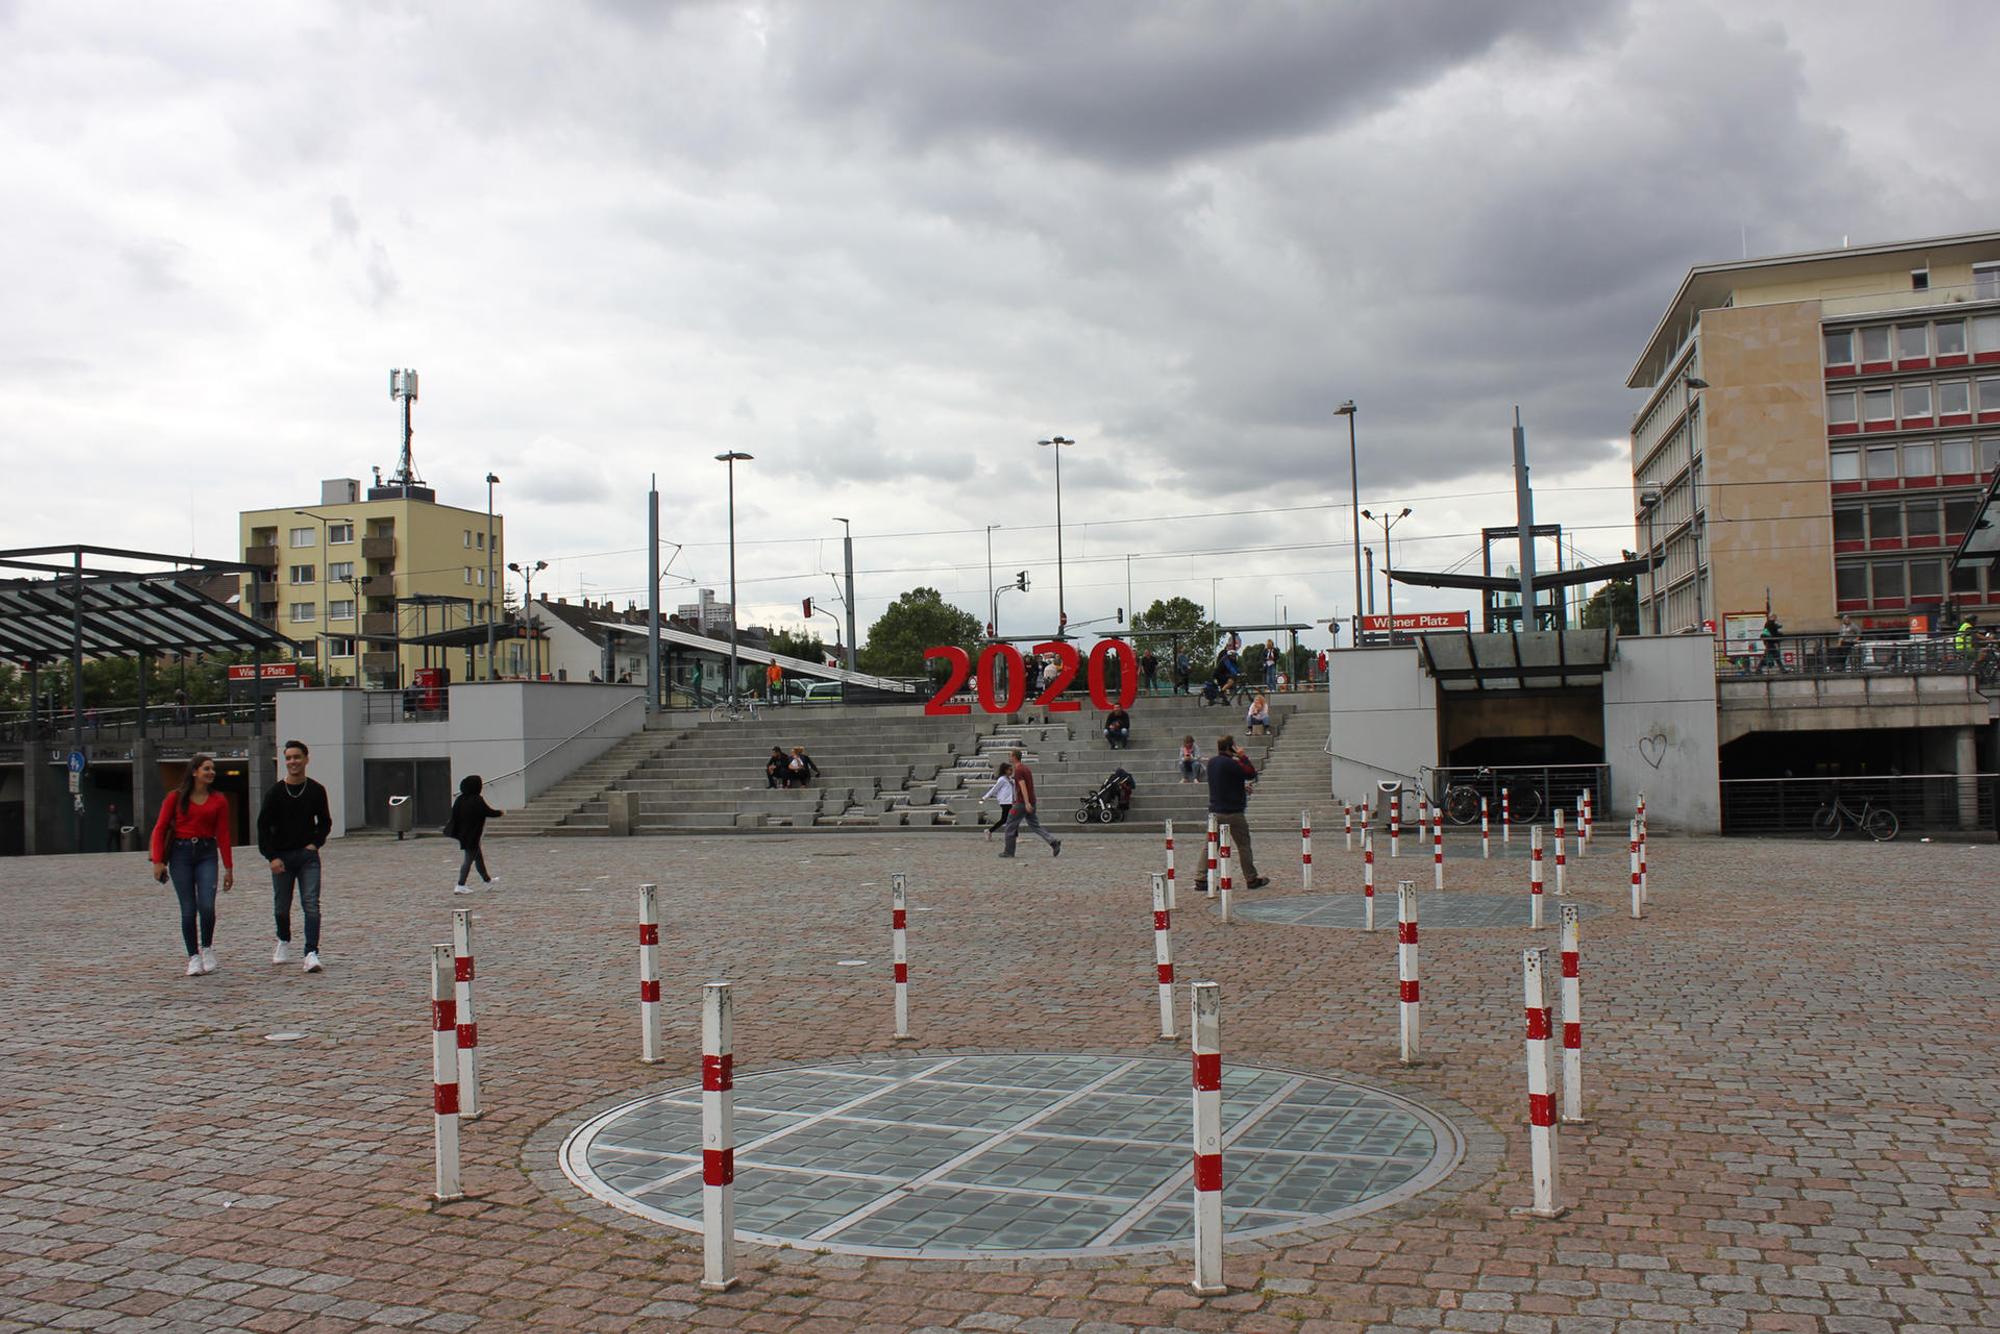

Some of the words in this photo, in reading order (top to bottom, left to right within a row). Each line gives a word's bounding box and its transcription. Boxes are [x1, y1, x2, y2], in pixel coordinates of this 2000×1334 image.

[1420, 615, 1449, 626] Platz
[267, 666, 286, 676] Platz
[923, 639, 1138, 716] 2020
